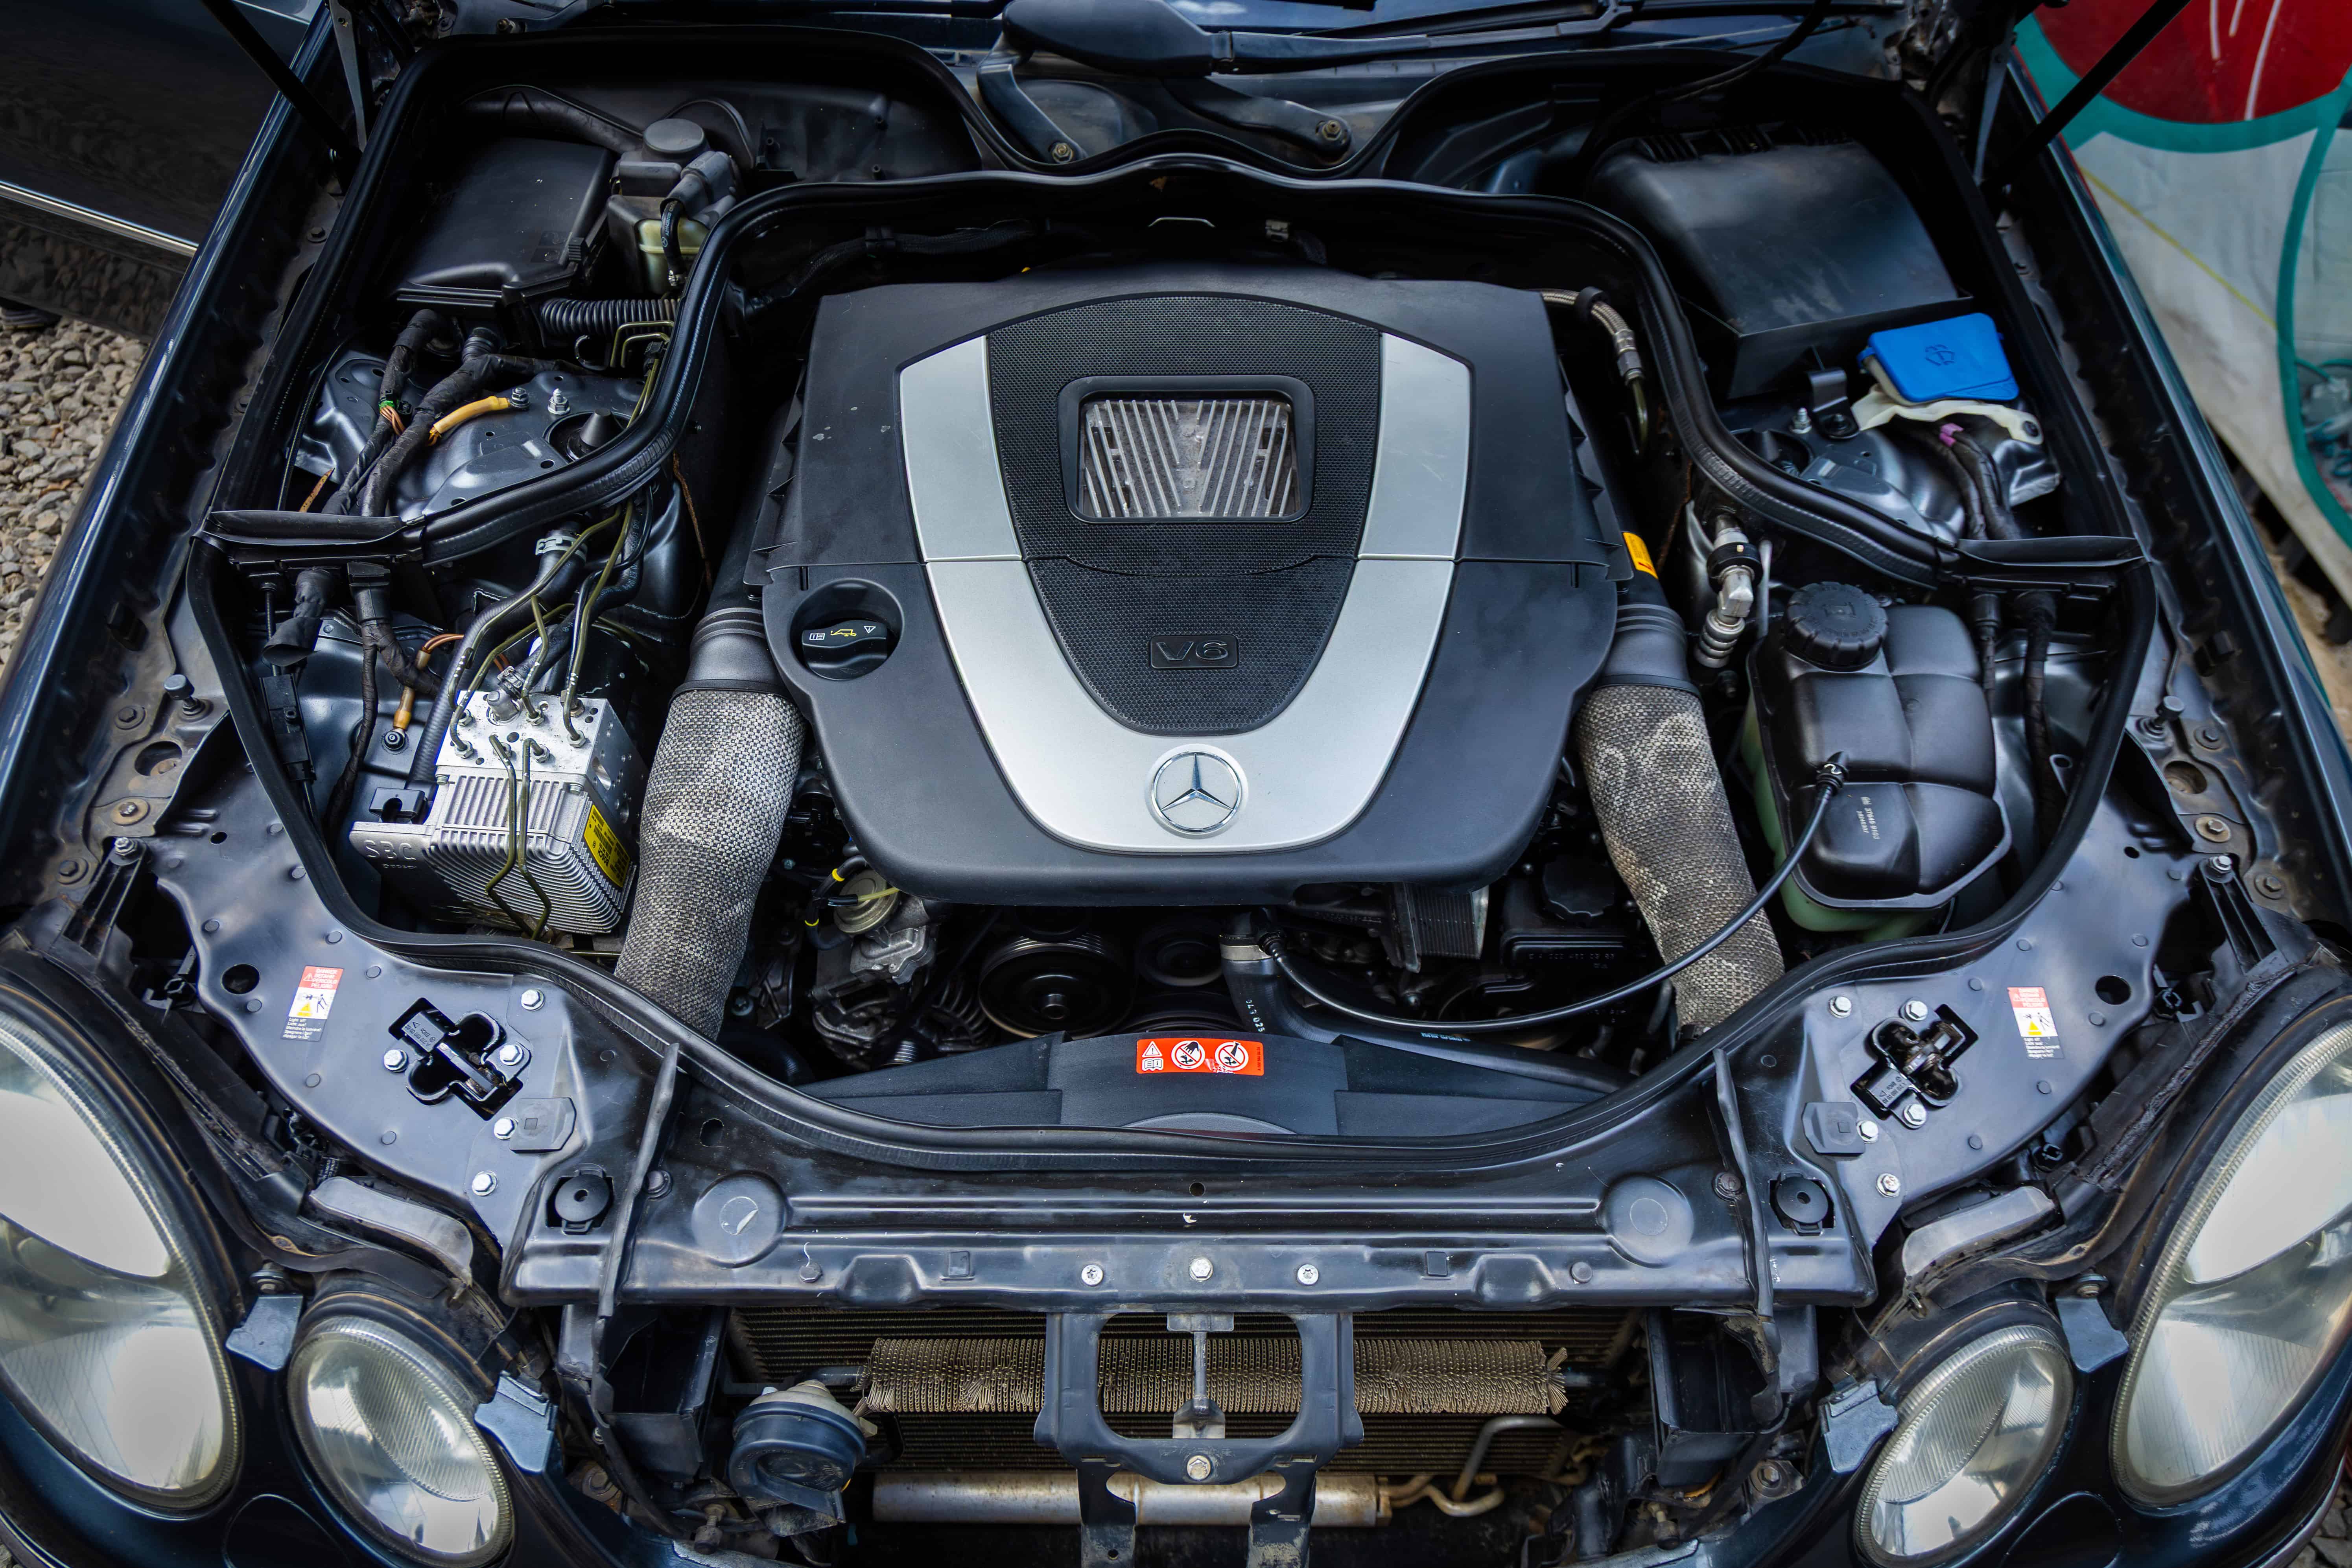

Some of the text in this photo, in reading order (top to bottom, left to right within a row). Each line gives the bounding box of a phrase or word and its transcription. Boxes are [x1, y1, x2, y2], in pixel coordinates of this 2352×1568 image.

[1156, 640, 1229, 661] V6
[364, 839, 418, 862] SBC
[597, 848, 610, 867] BOSCH
[1253, 1017, 1265, 1032] 025
